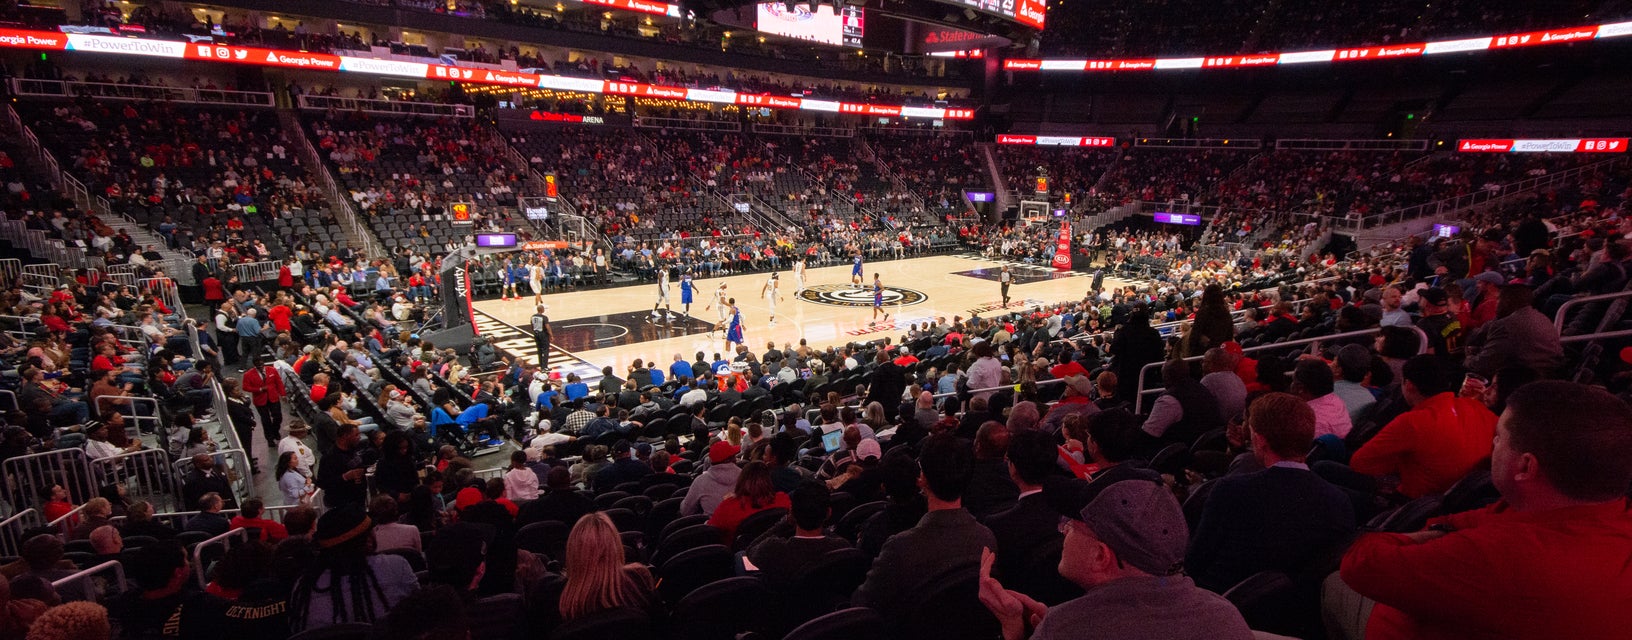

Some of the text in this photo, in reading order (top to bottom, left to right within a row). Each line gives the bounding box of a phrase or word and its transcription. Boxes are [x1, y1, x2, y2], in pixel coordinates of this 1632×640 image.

[1552, 31, 1593, 41] Georgia Power
[0, 37, 57, 46] orgia Power
[84, 38, 174, 54] #PowerToWin
[280, 55, 334, 67] Georgia Power
[353, 60, 419, 74] #PowerToWin
[495, 74, 535, 84] Georgia Power
[582, 116, 604, 124] ARENA
[1521, 142, 1572, 150] #PowerToWin
[454, 266, 467, 297] xfinity
